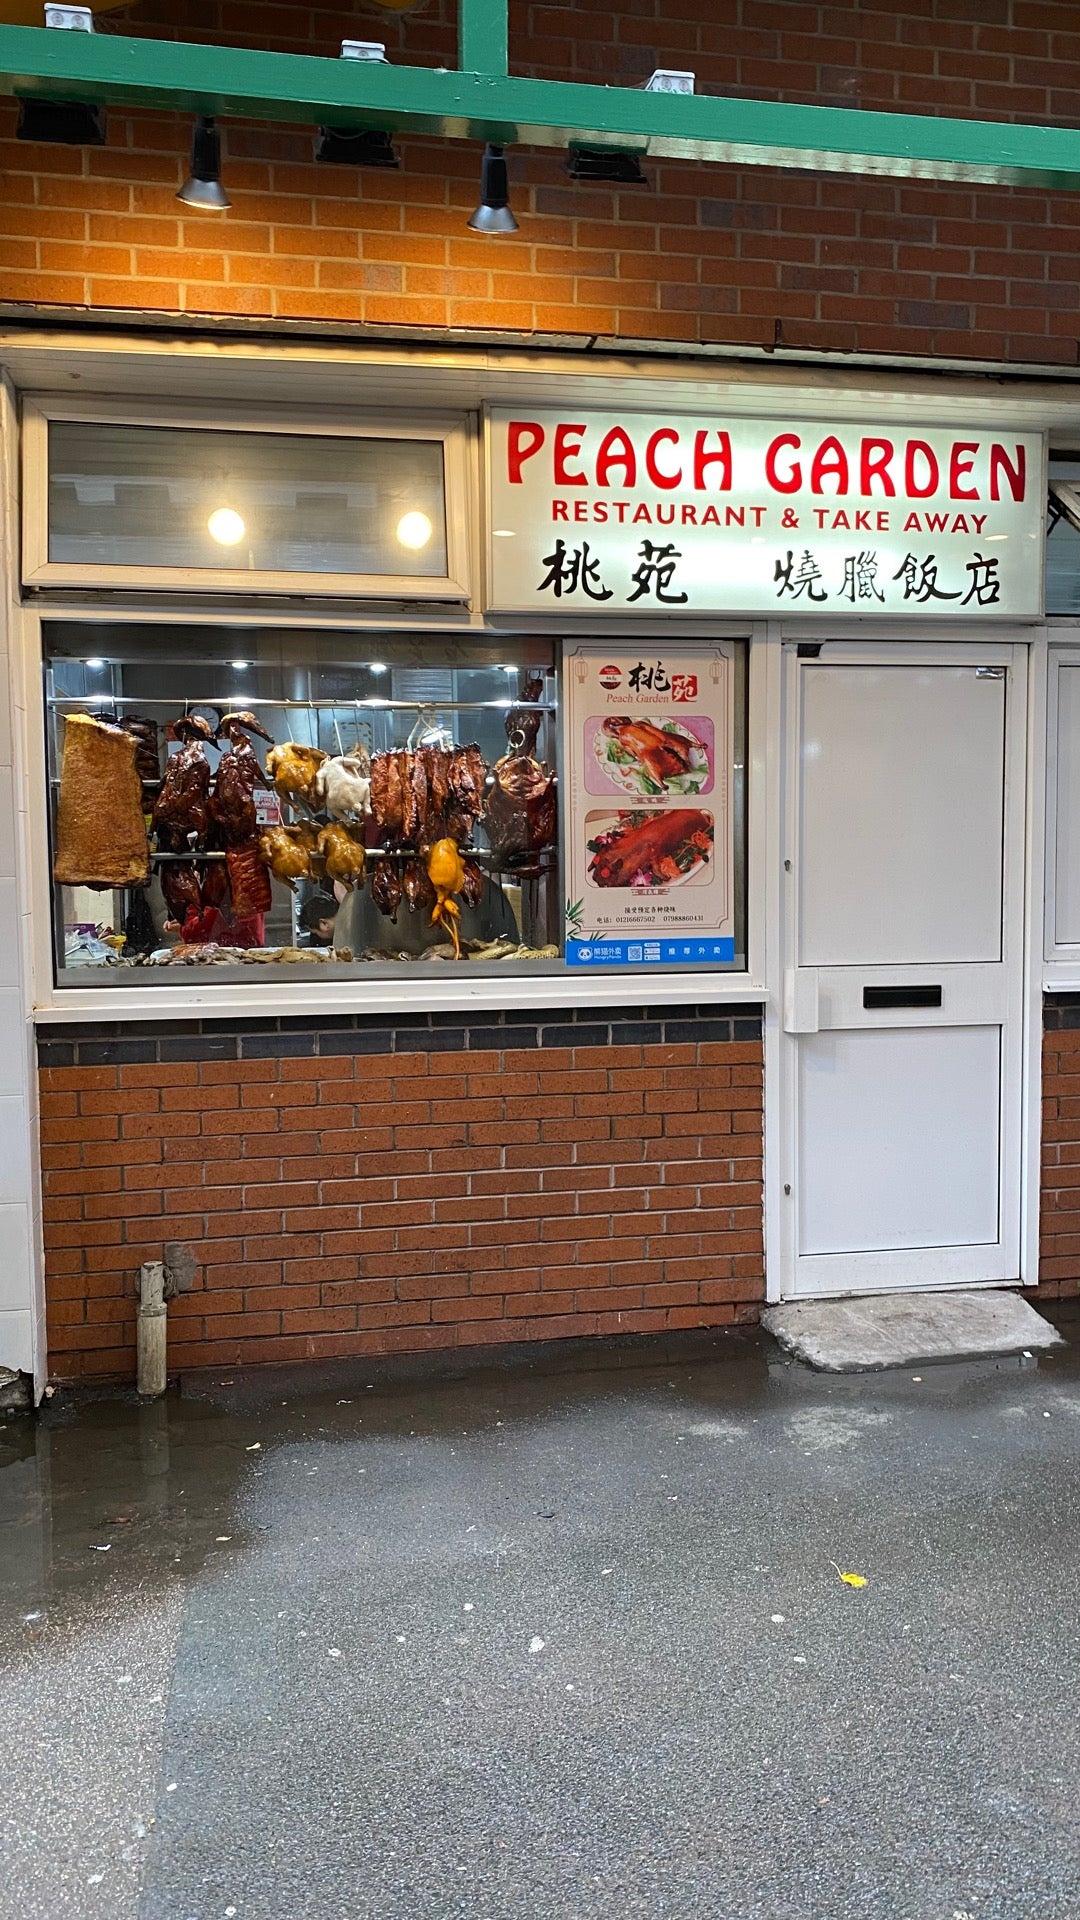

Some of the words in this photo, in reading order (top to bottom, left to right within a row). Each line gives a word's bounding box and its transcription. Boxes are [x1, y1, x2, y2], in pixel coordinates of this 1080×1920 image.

[508, 421, 732, 491] PEACH
[765, 433, 1026, 502] GARDEN
[552, 500, 767, 527] RESTAURANT
[781, 507, 800, 528] &
[813, 509, 890, 531] TAKE
[903, 512, 988, 534] AWAY
[536, 539, 689, 604] 桃苑
[773, 549, 1001, 606] 燒臘飯店
[606, 693, 634, 703] Peach
[636, 693, 669, 703] Garden
[628, 660, 698, 702] 桃苑
